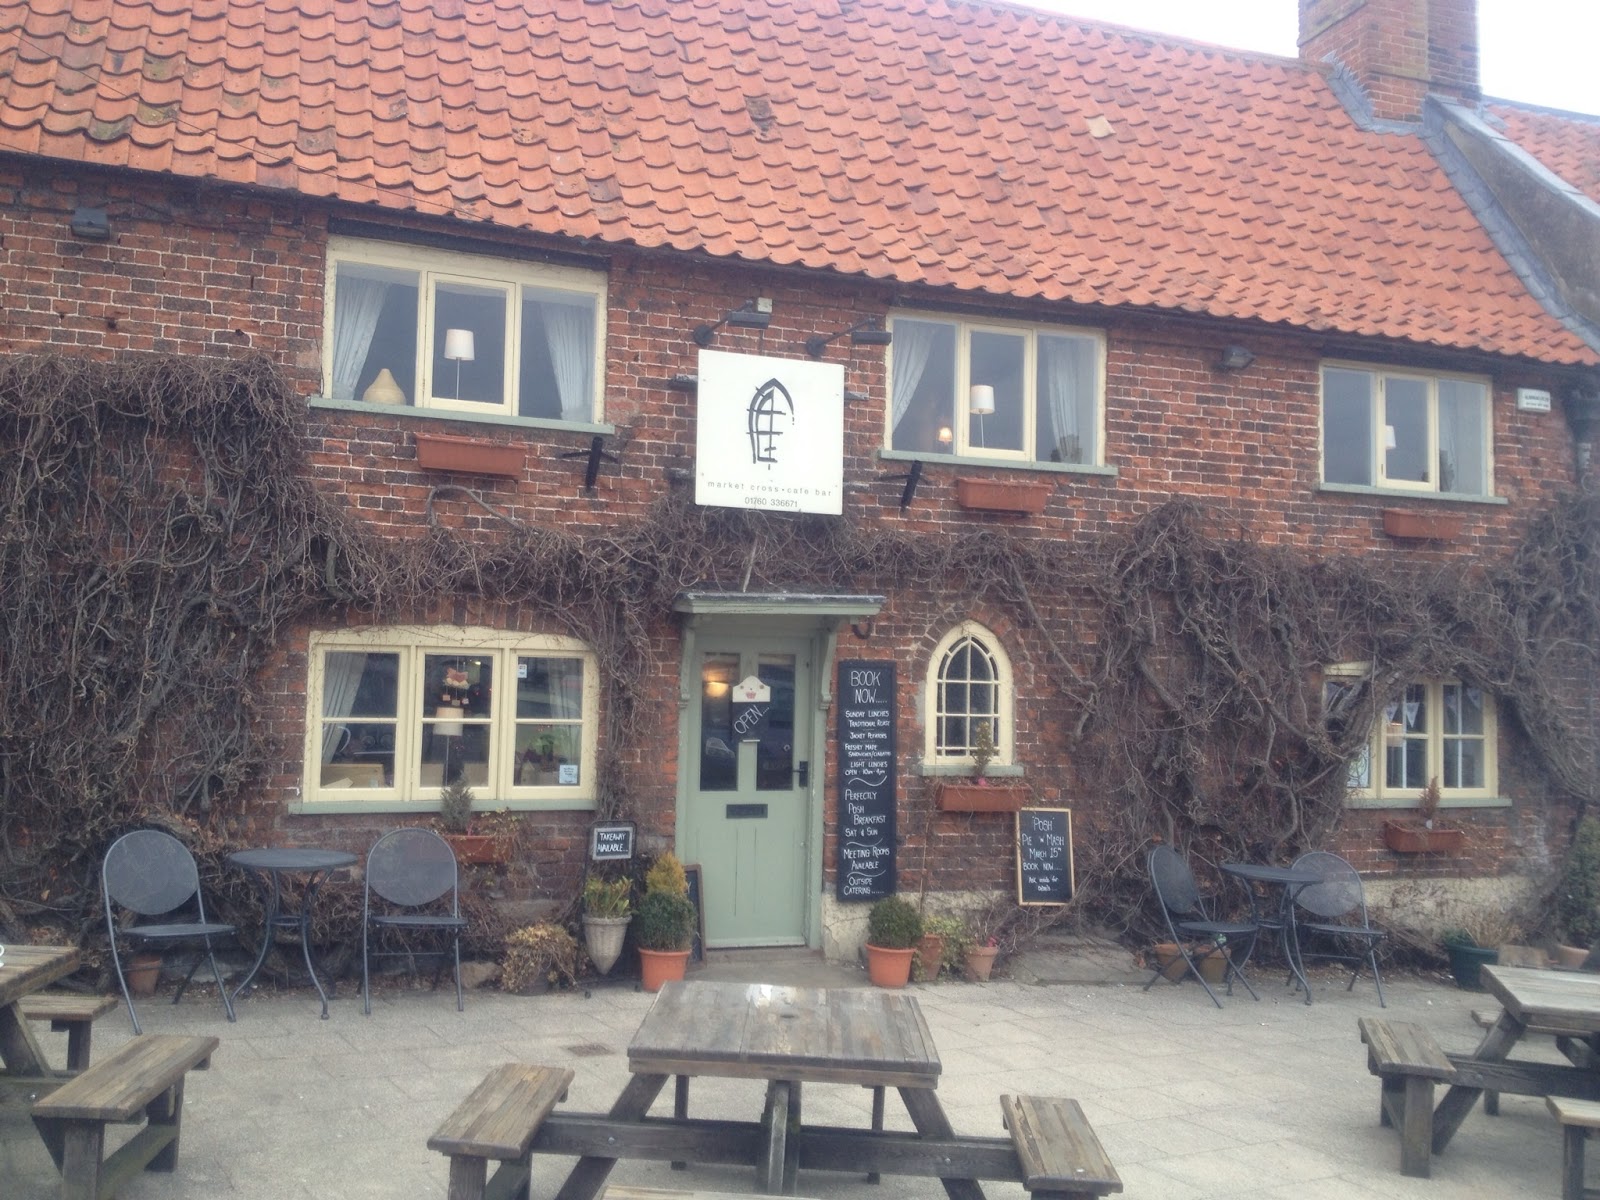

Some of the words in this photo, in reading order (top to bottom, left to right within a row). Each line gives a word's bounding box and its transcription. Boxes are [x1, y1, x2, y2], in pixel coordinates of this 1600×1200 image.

[707, 481, 744, 489] market
[750, 484, 779, 492] cross
[815, 489, 831, 497] bar
[850, 670, 881, 687] BOOK
[845, 710, 866, 718] SUNDAY
[868, 710, 890, 718] LUNCHES
[844, 788, 878, 801] PERFECTLY
[848, 802, 865, 815] POSH
[853, 814, 887, 826] BREAKFAST
[599, 832, 627, 842] TAKEAWAY
[845, 827, 857, 838] SAT
[866, 826, 879, 836] SUN
[1021, 833, 1033, 846] PIE
[1046, 833, 1065, 846] MASH
[843, 848, 871, 860] MEETING
[872, 846, 890, 859] ROOMS
[1029, 848, 1047, 861] MARCH
[851, 860, 880, 871] AVAILABLE
[1022, 861, 1040, 871] BOOK
[848, 876, 873, 887] OUTSIDE
